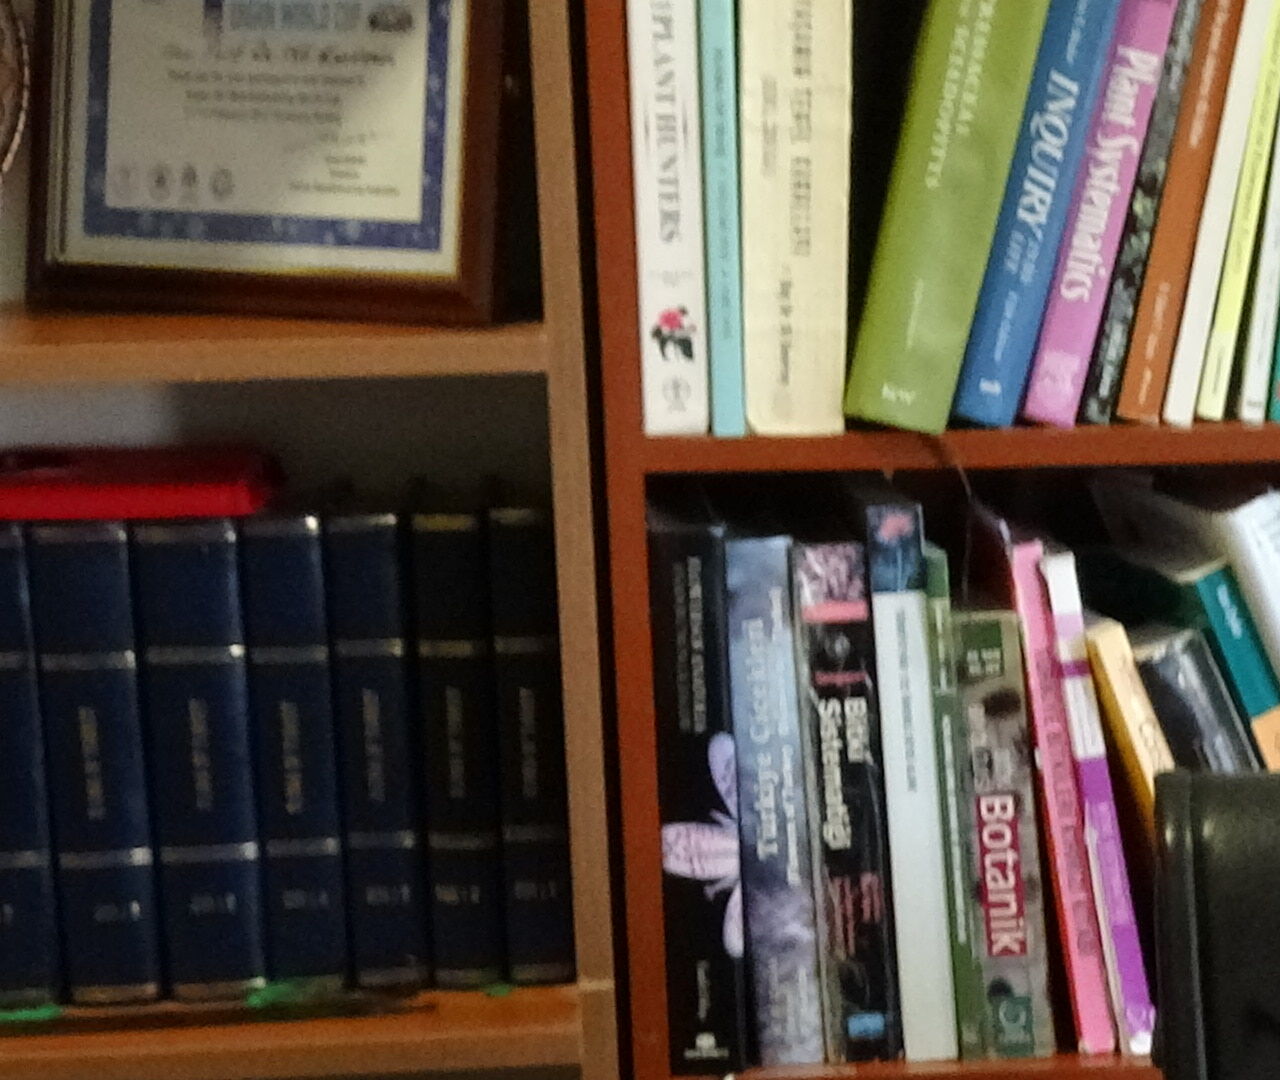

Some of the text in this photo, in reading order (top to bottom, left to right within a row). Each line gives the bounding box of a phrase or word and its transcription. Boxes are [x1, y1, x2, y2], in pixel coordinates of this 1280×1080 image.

[1016, 70, 1080, 242] INQUIRY
[1059, 44, 1160, 304] Plant Systematics
[843, 695, 873, 764] Bitki
[978, 795, 1027, 957] Botanik
